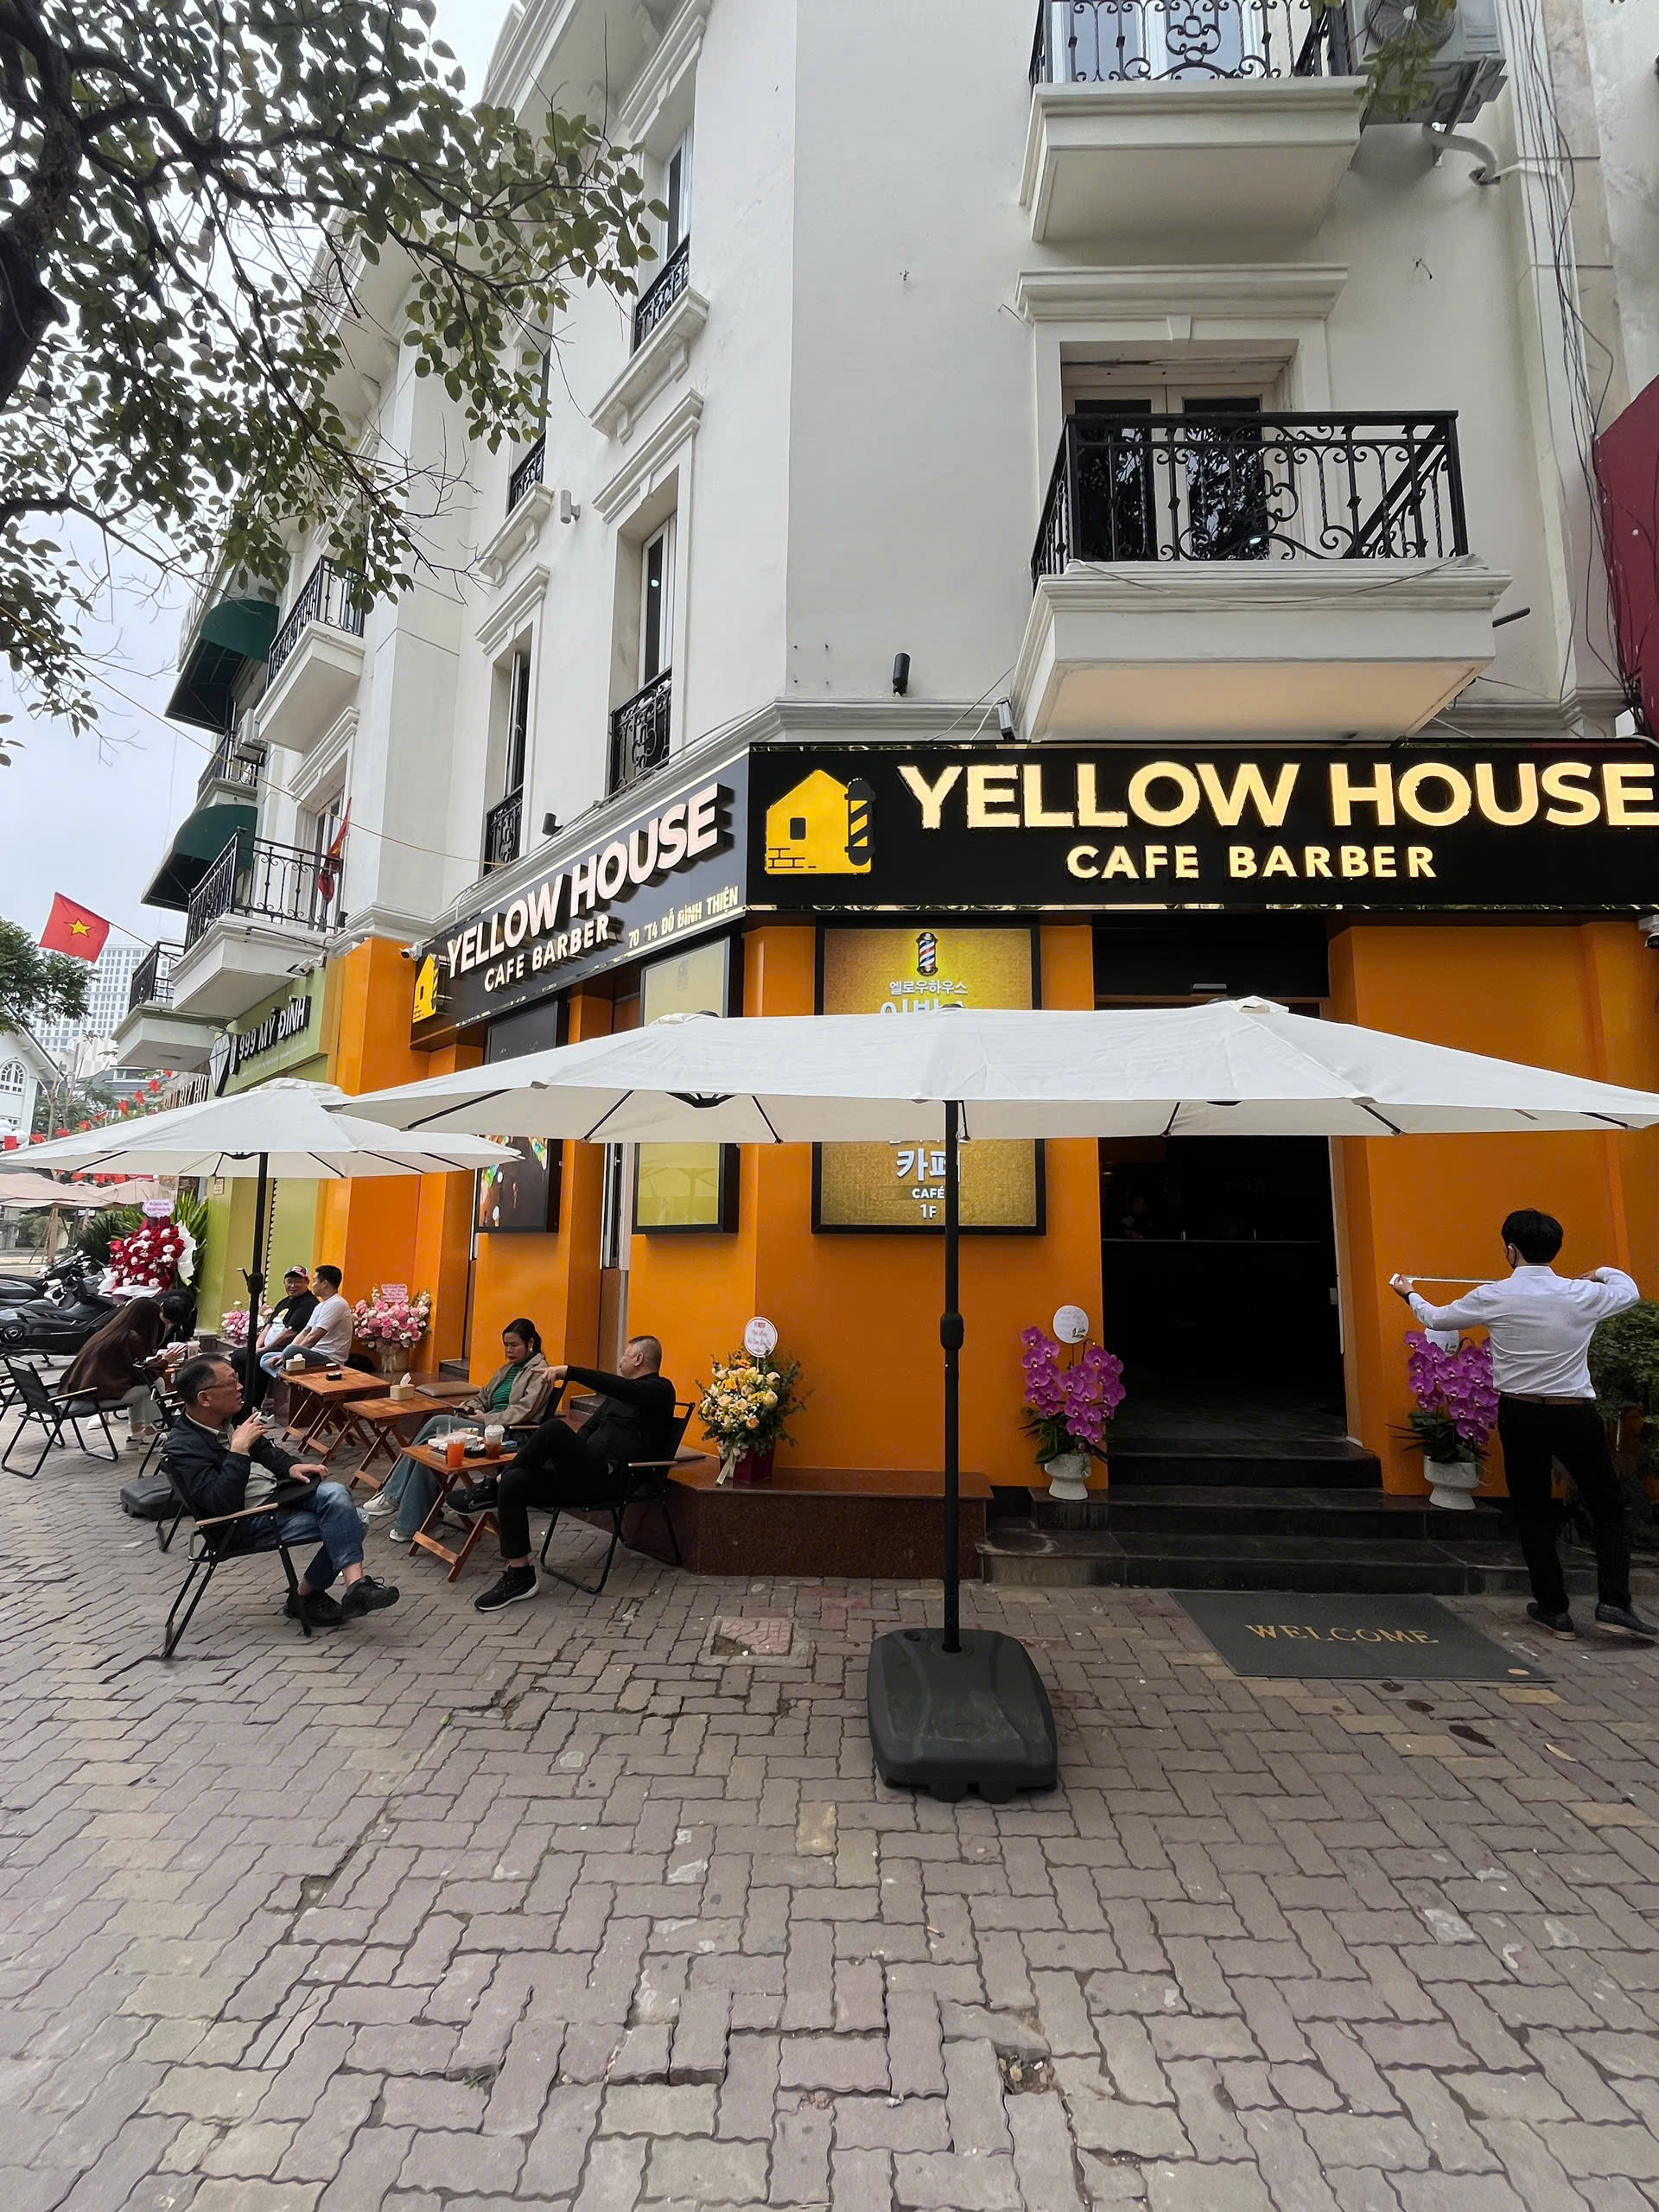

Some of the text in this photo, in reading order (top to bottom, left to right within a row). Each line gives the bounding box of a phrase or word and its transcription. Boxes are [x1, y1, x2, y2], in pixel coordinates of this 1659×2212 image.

[899, 760, 1659, 830] YELLOW HOUSE
[447, 783, 718, 979] YELLOW HOUSE
[1067, 844, 1437, 880] CAFE BARBER
[628, 928, 640, 949] 70
[677, 901, 702, 929] ĐÌNH
[706, 886, 739, 916] THIỆN
[484, 914, 610, 993] CAFE BARBER
[238, 1028, 257, 1060] 999
[920, 1204, 937, 1218] 1F
[1245, 1624, 1440, 1644] WELCOME
